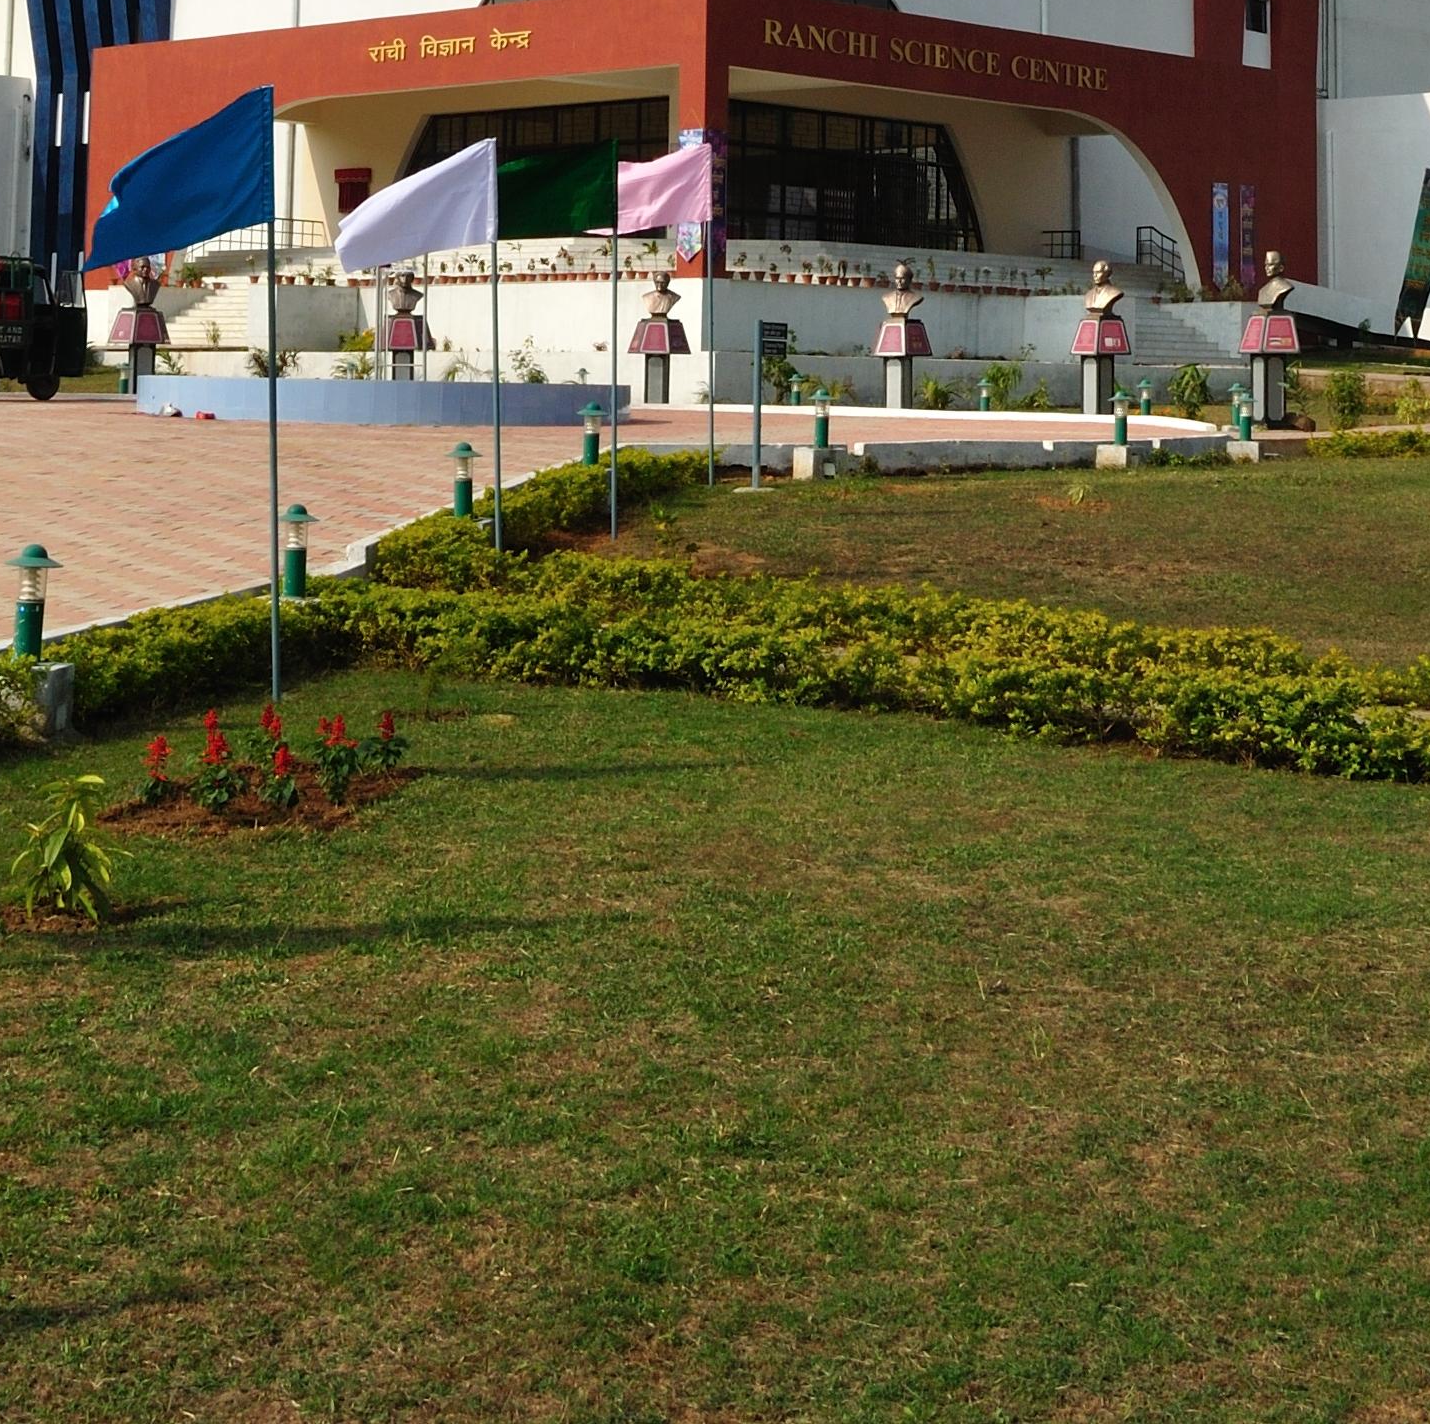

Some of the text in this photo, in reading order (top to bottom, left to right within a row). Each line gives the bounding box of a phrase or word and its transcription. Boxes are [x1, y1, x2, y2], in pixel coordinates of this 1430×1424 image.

[368, 28, 532, 62] रांची विज्ञान केन्द्र
[763, 19, 1109, 92] RANCHI SCIENCE CENTRE
